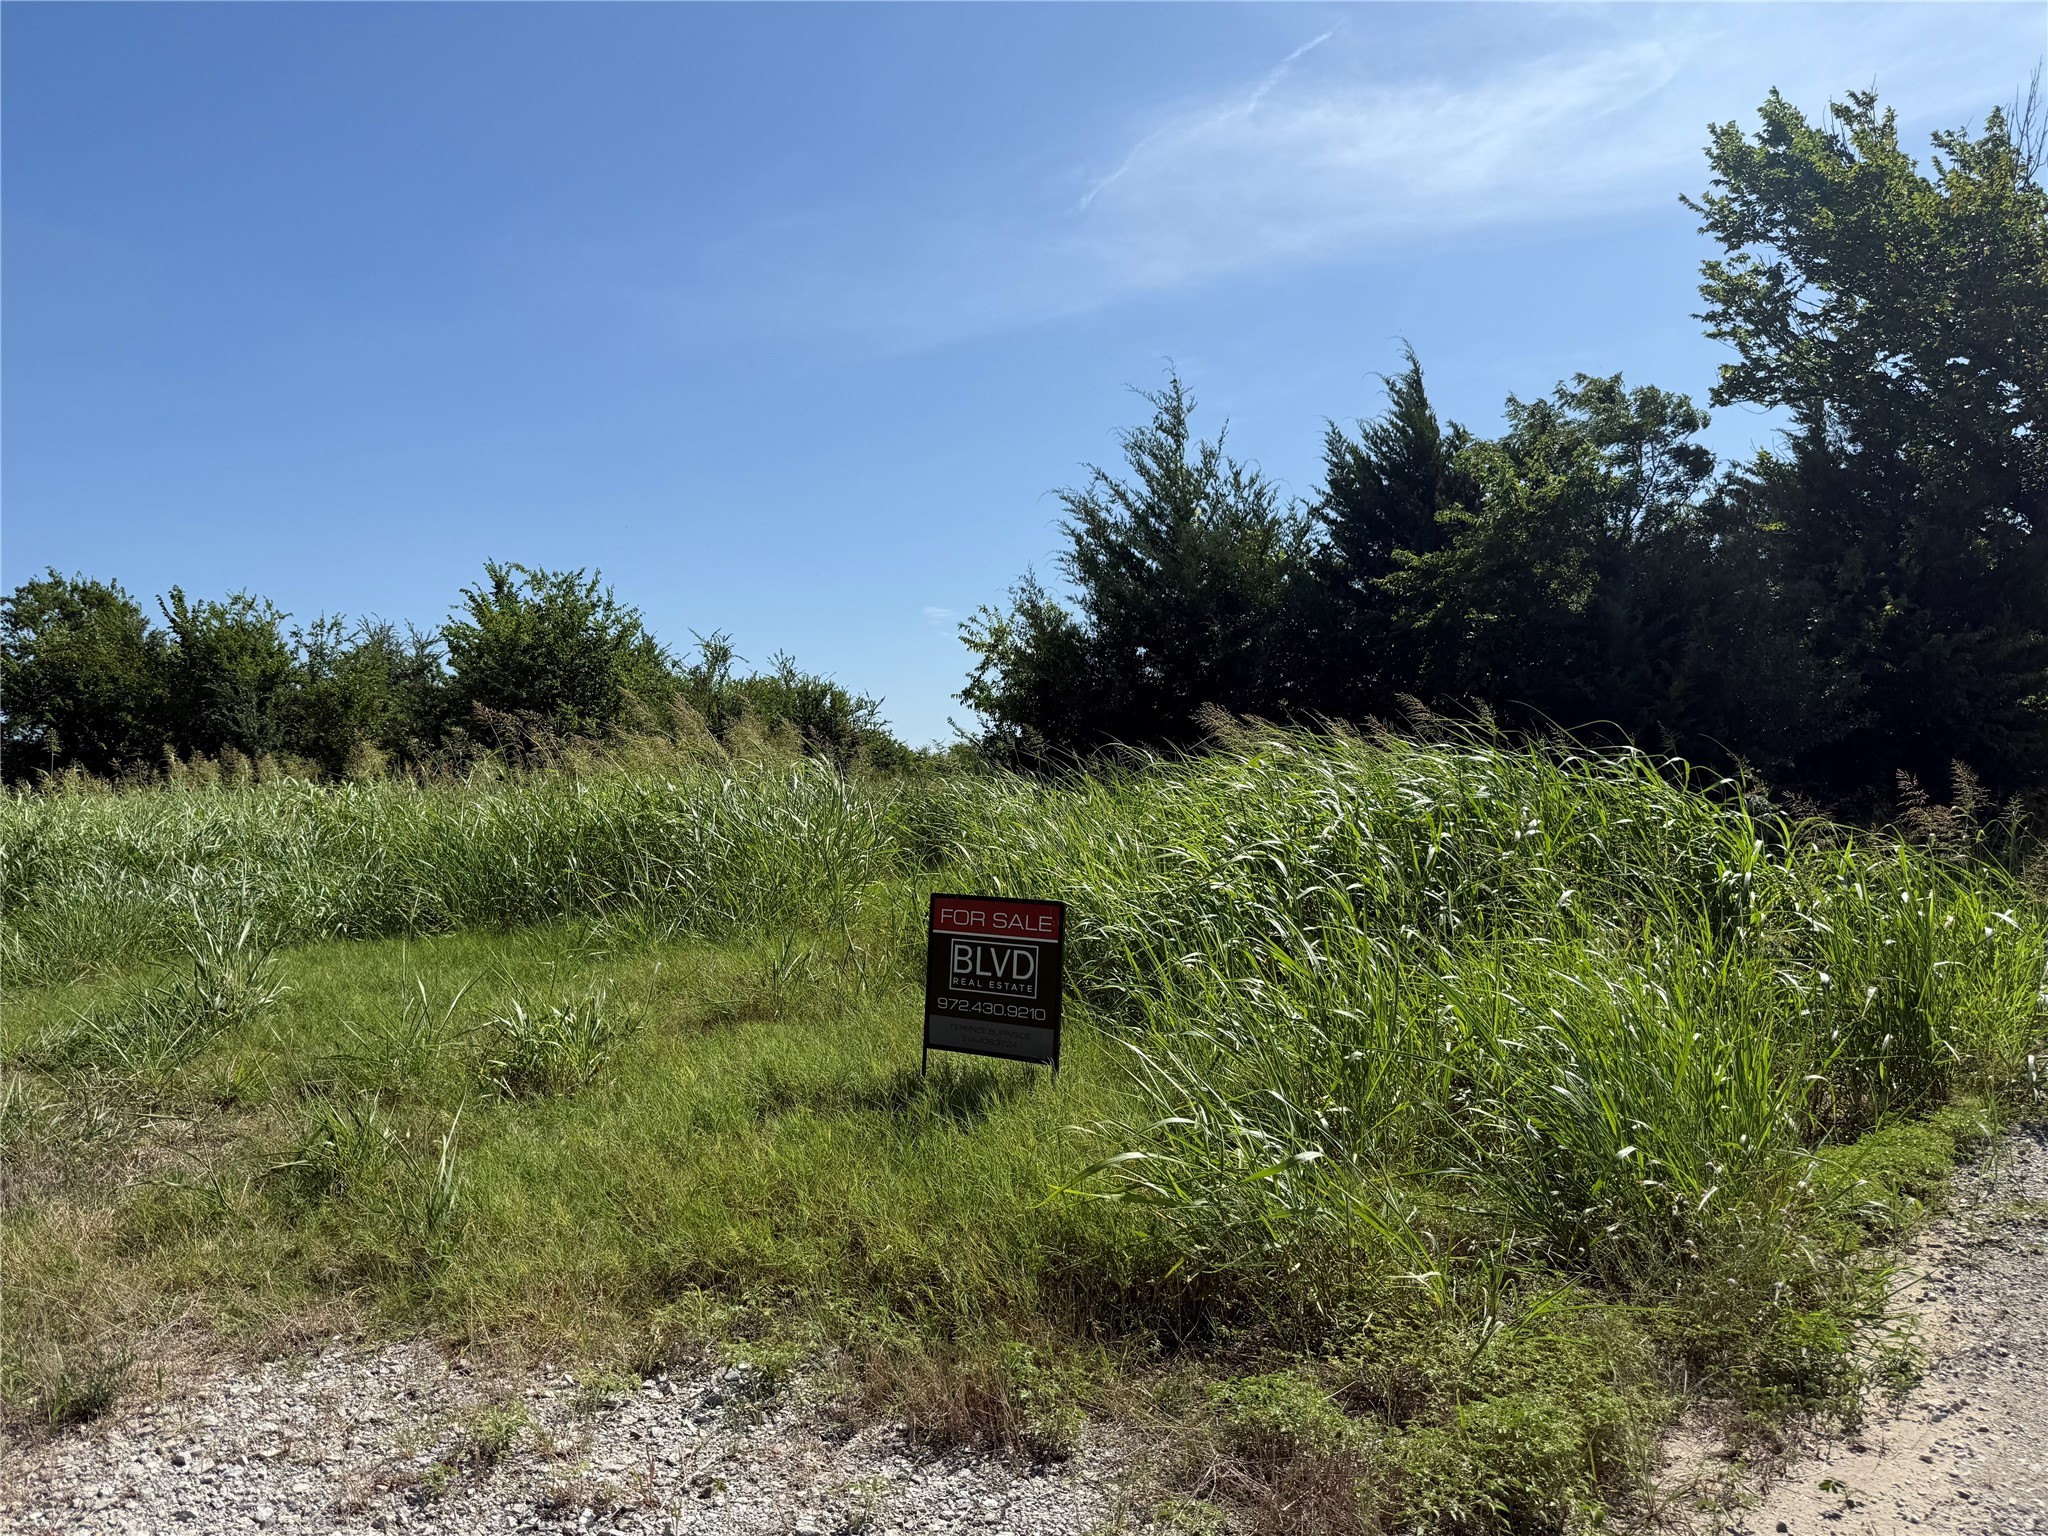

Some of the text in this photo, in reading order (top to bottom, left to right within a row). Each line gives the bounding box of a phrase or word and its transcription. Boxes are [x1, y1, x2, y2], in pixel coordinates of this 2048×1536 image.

[941, 908, 1053, 932] FOR SALE
[953, 944, 1034, 980] BLVD
[952, 977, 1033, 993] REAL ESTATE
[937, 997, 1046, 1021] 972.430.9210
